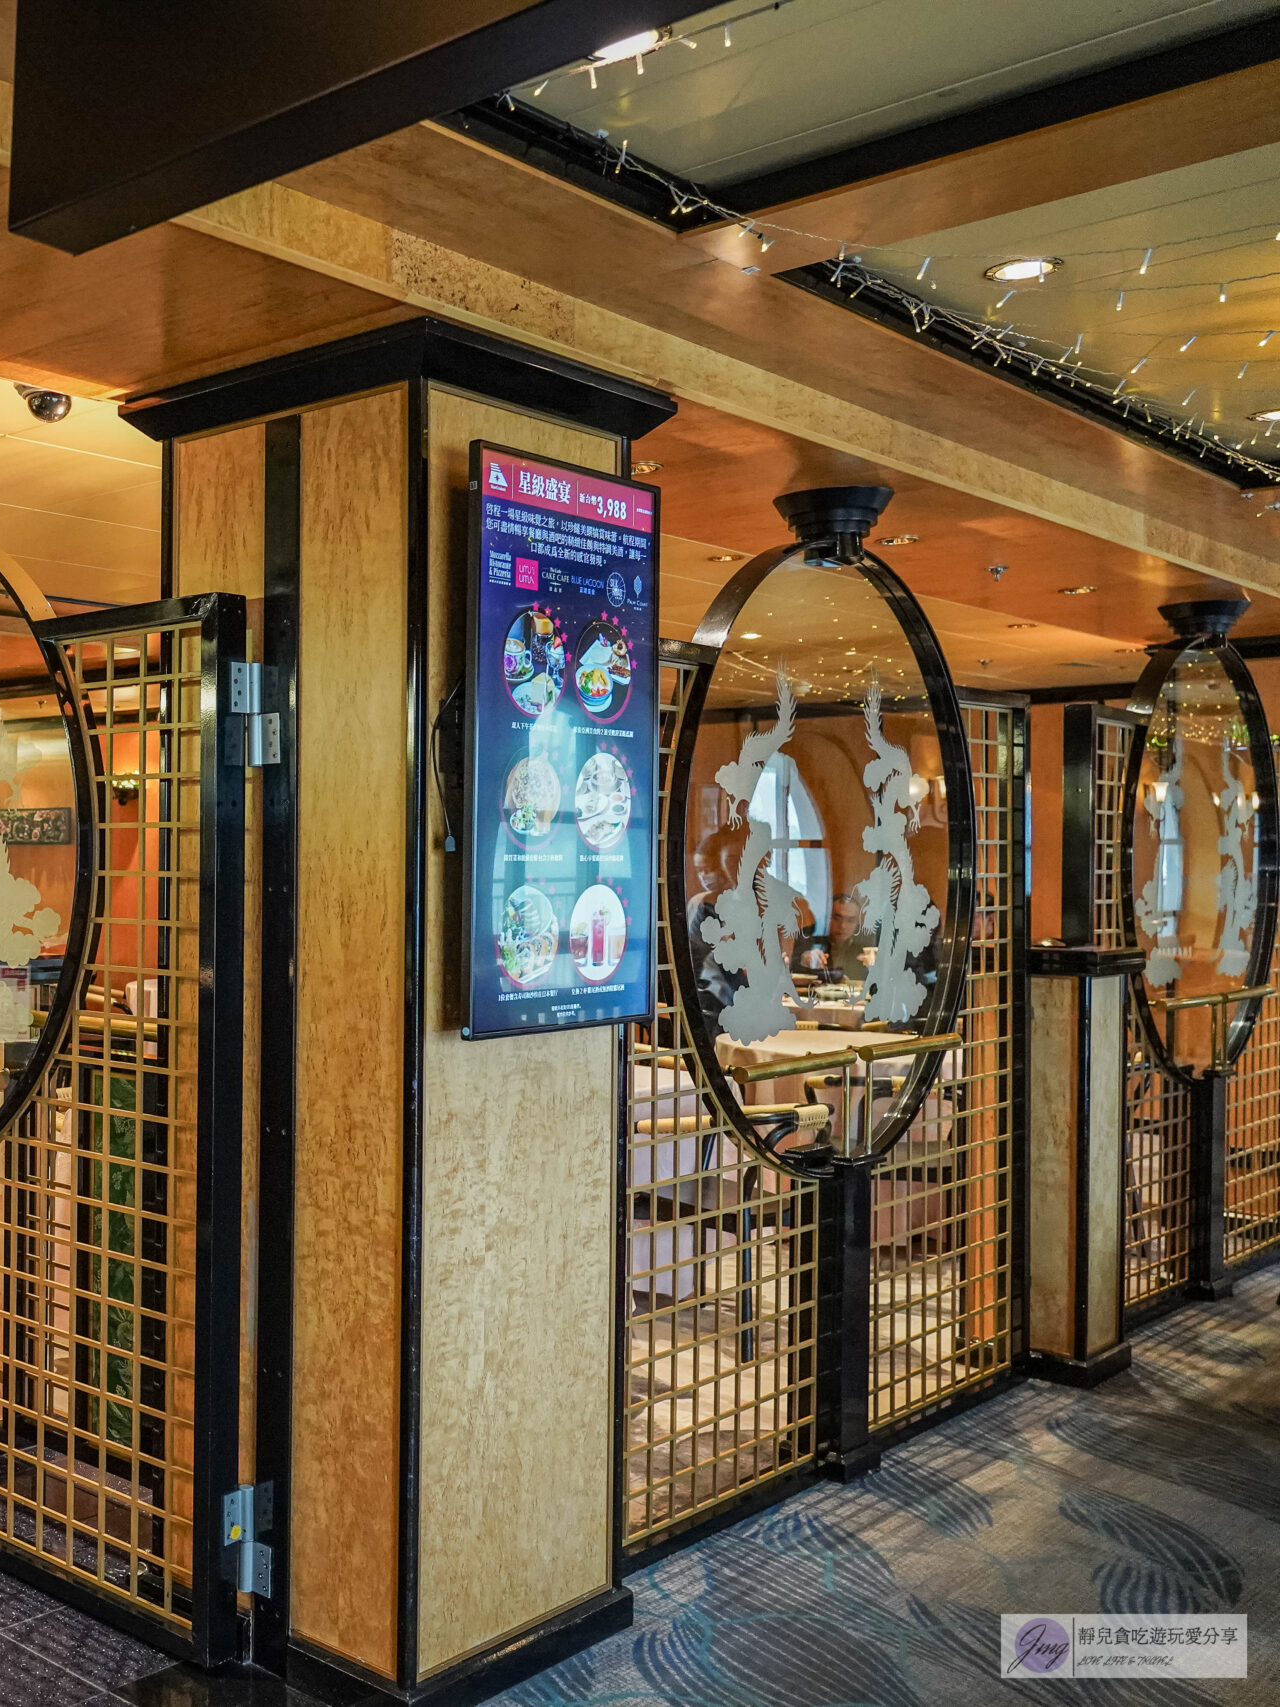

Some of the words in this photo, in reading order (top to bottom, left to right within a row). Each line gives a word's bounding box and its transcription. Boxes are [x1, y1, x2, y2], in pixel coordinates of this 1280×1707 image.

[518, 470, 571, 504] 星級盛宴
[597, 495, 627, 520] 3,988
[541, 571, 556, 581] CAKE
